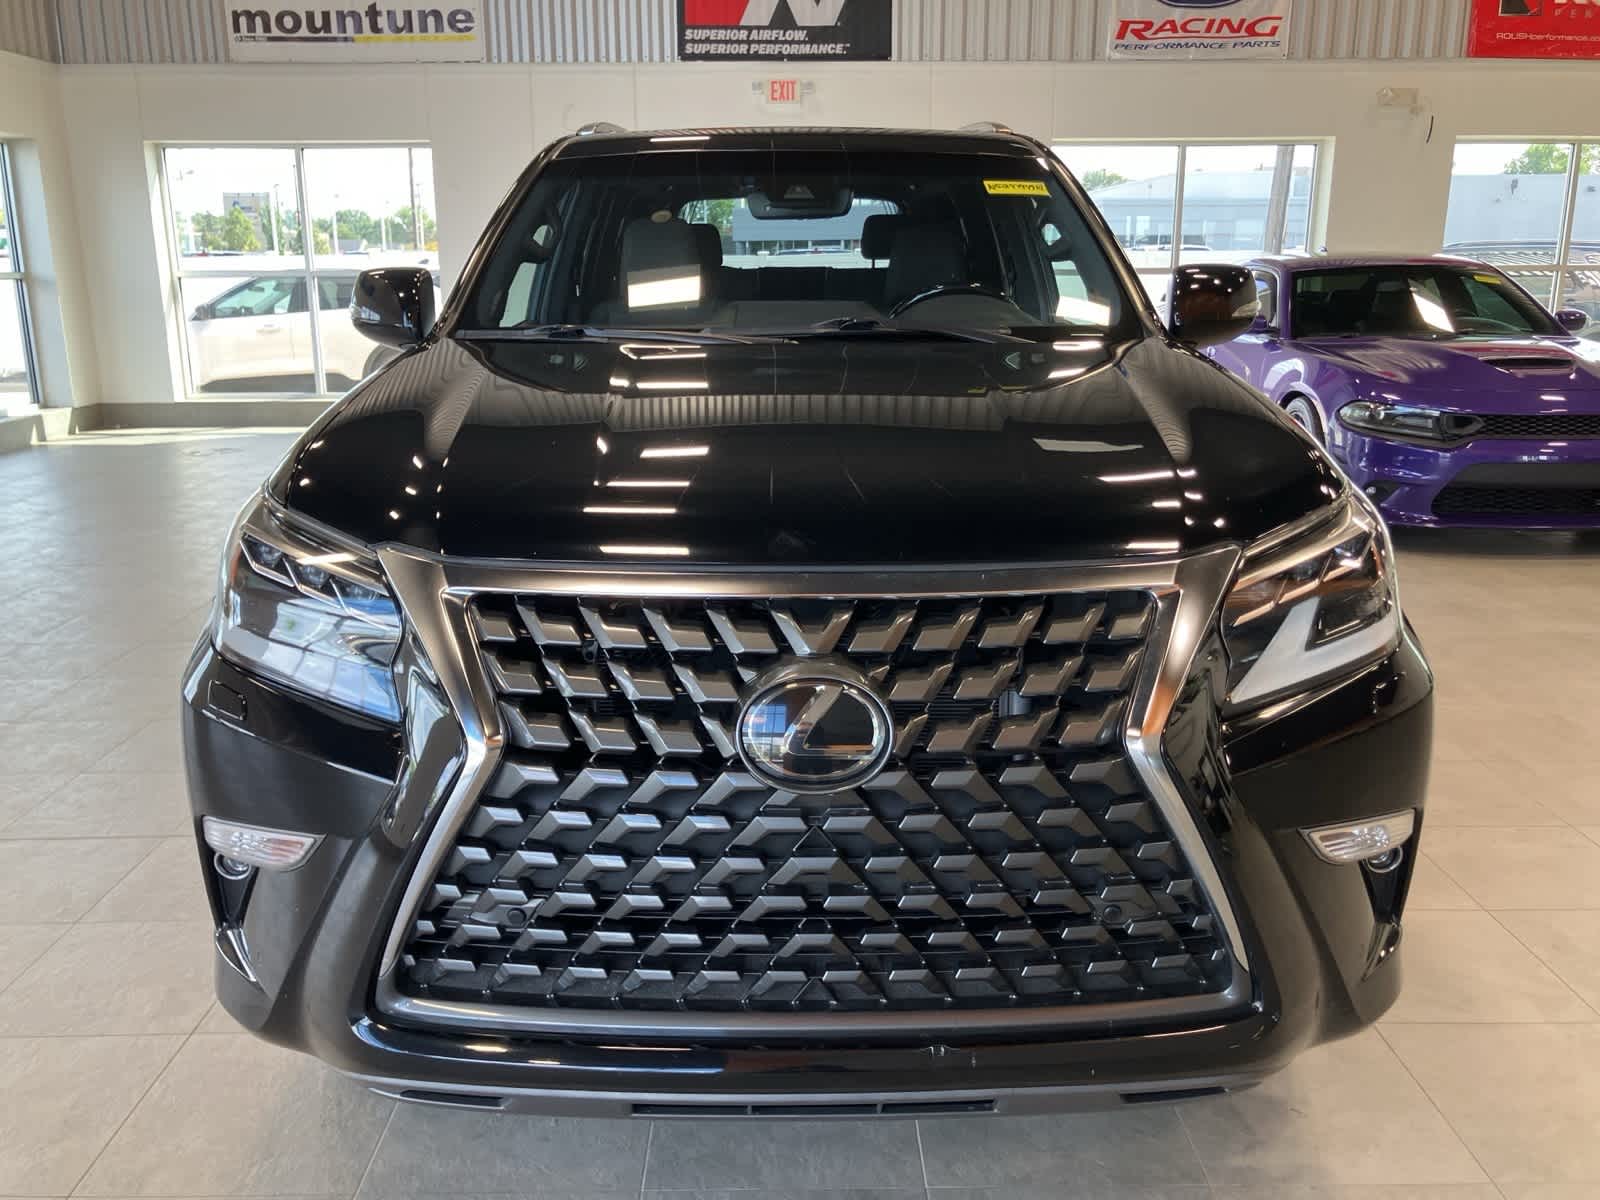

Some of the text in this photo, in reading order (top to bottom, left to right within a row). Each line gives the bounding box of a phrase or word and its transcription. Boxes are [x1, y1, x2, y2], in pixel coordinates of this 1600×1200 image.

[231, 2, 475, 34] mountune
[685, 29, 809, 41] SUPERIOR AIRFLOW.
[1115, 16, 1283, 40] RACING
[684, 43, 748, 55] SUPERIOR
[1114, 40, 1281, 51] PERFORMANCE PARTS
[771, 80, 797, 101] EXIT
